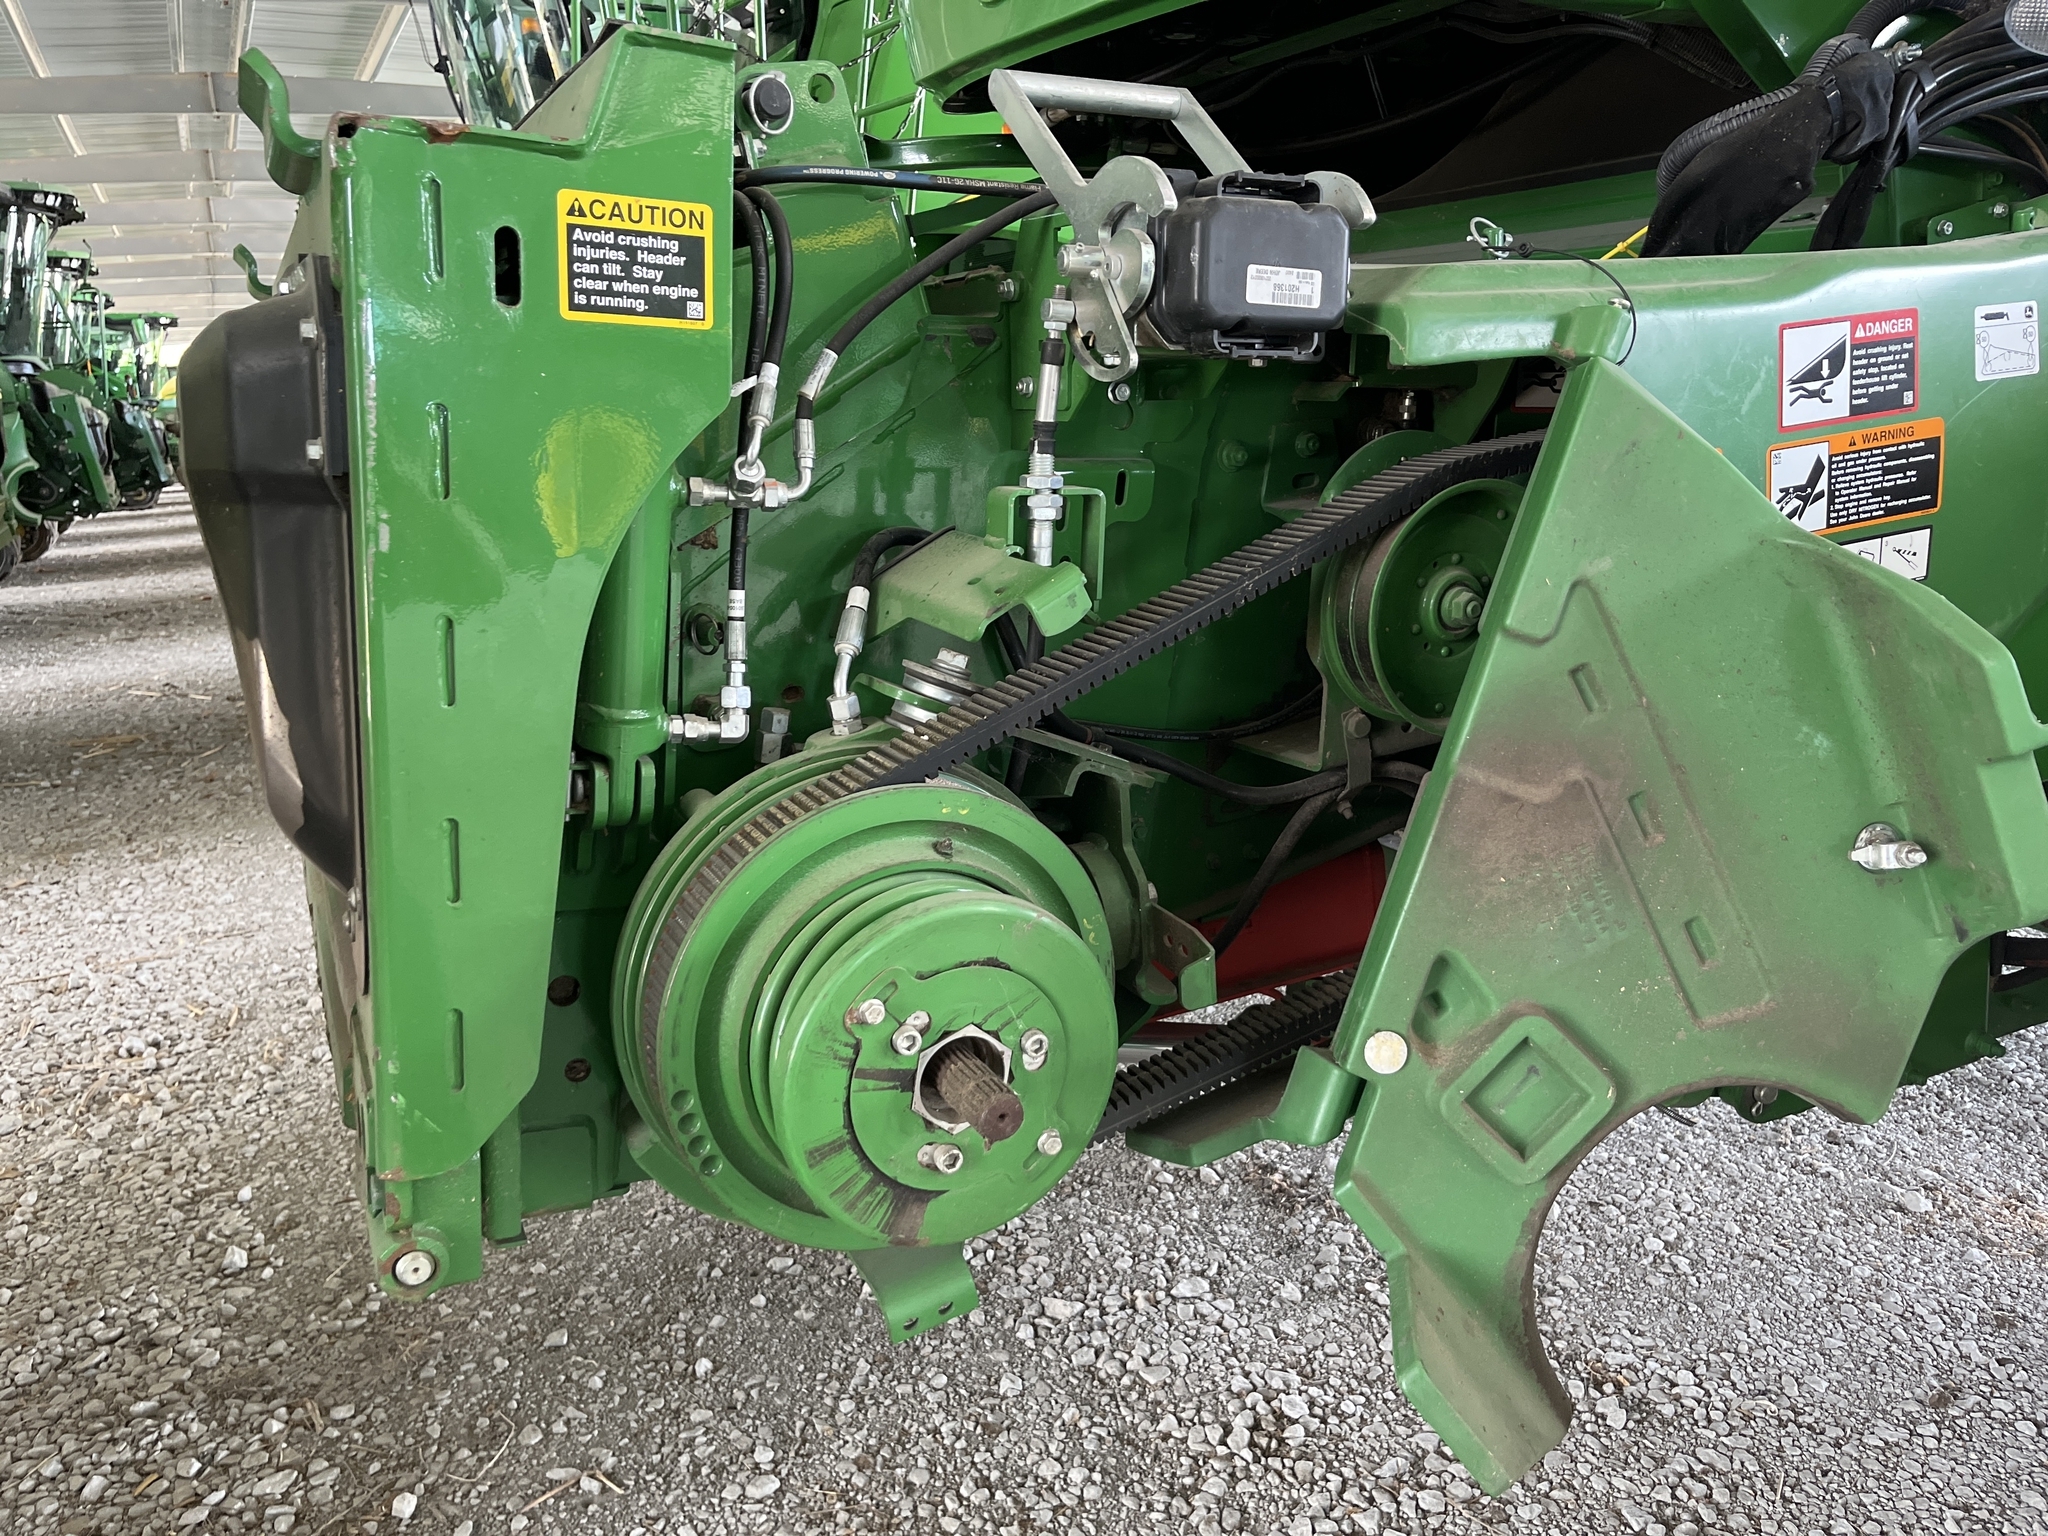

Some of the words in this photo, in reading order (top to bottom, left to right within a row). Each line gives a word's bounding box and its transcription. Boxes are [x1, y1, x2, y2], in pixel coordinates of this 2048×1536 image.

[845, 169, 878, 177] POWERING
[936, 176, 964, 184] 2G-11C
[965, 178, 986, 186] MSHA
[987, 180, 1019, 190] Resistant
[1021, 183, 1041, 192] Flame
[589, 199, 704, 230] CAUTION
[572, 228, 614, 244] Avoid
[618, 234, 679, 253] crushing
[573, 244, 630, 261] injuries.
[637, 250, 686, 266] Header
[573, 262, 599, 274] can
[602, 263, 625, 276] tilt.
[632, 265, 663, 282] Stay
[573, 277, 609, 290] clear
[612, 280, 649, 294] when
[652, 285, 699, 299] engine
[1273, 282, 1300, 292] H201368
[574, 291, 587, 305] is
[590, 295, 648, 312] running.
[1866, 318, 1913, 336] DANGER
[1853, 348, 1866, 356] Avoid
[1877, 354, 1893, 363] ground
[1852, 376, 1880, 385] feederhouse
[1868, 385, 1884, 394] getting
[1852, 397, 1869, 405] header.
[1862, 426, 1914, 444] WARNING
[1908, 441, 1925, 449] hydraulic
[1865, 463, 1882, 471] hydraulic
[1858, 504, 1879, 512] NITROGEN
[1887, 499, 1907, 507] recharging
